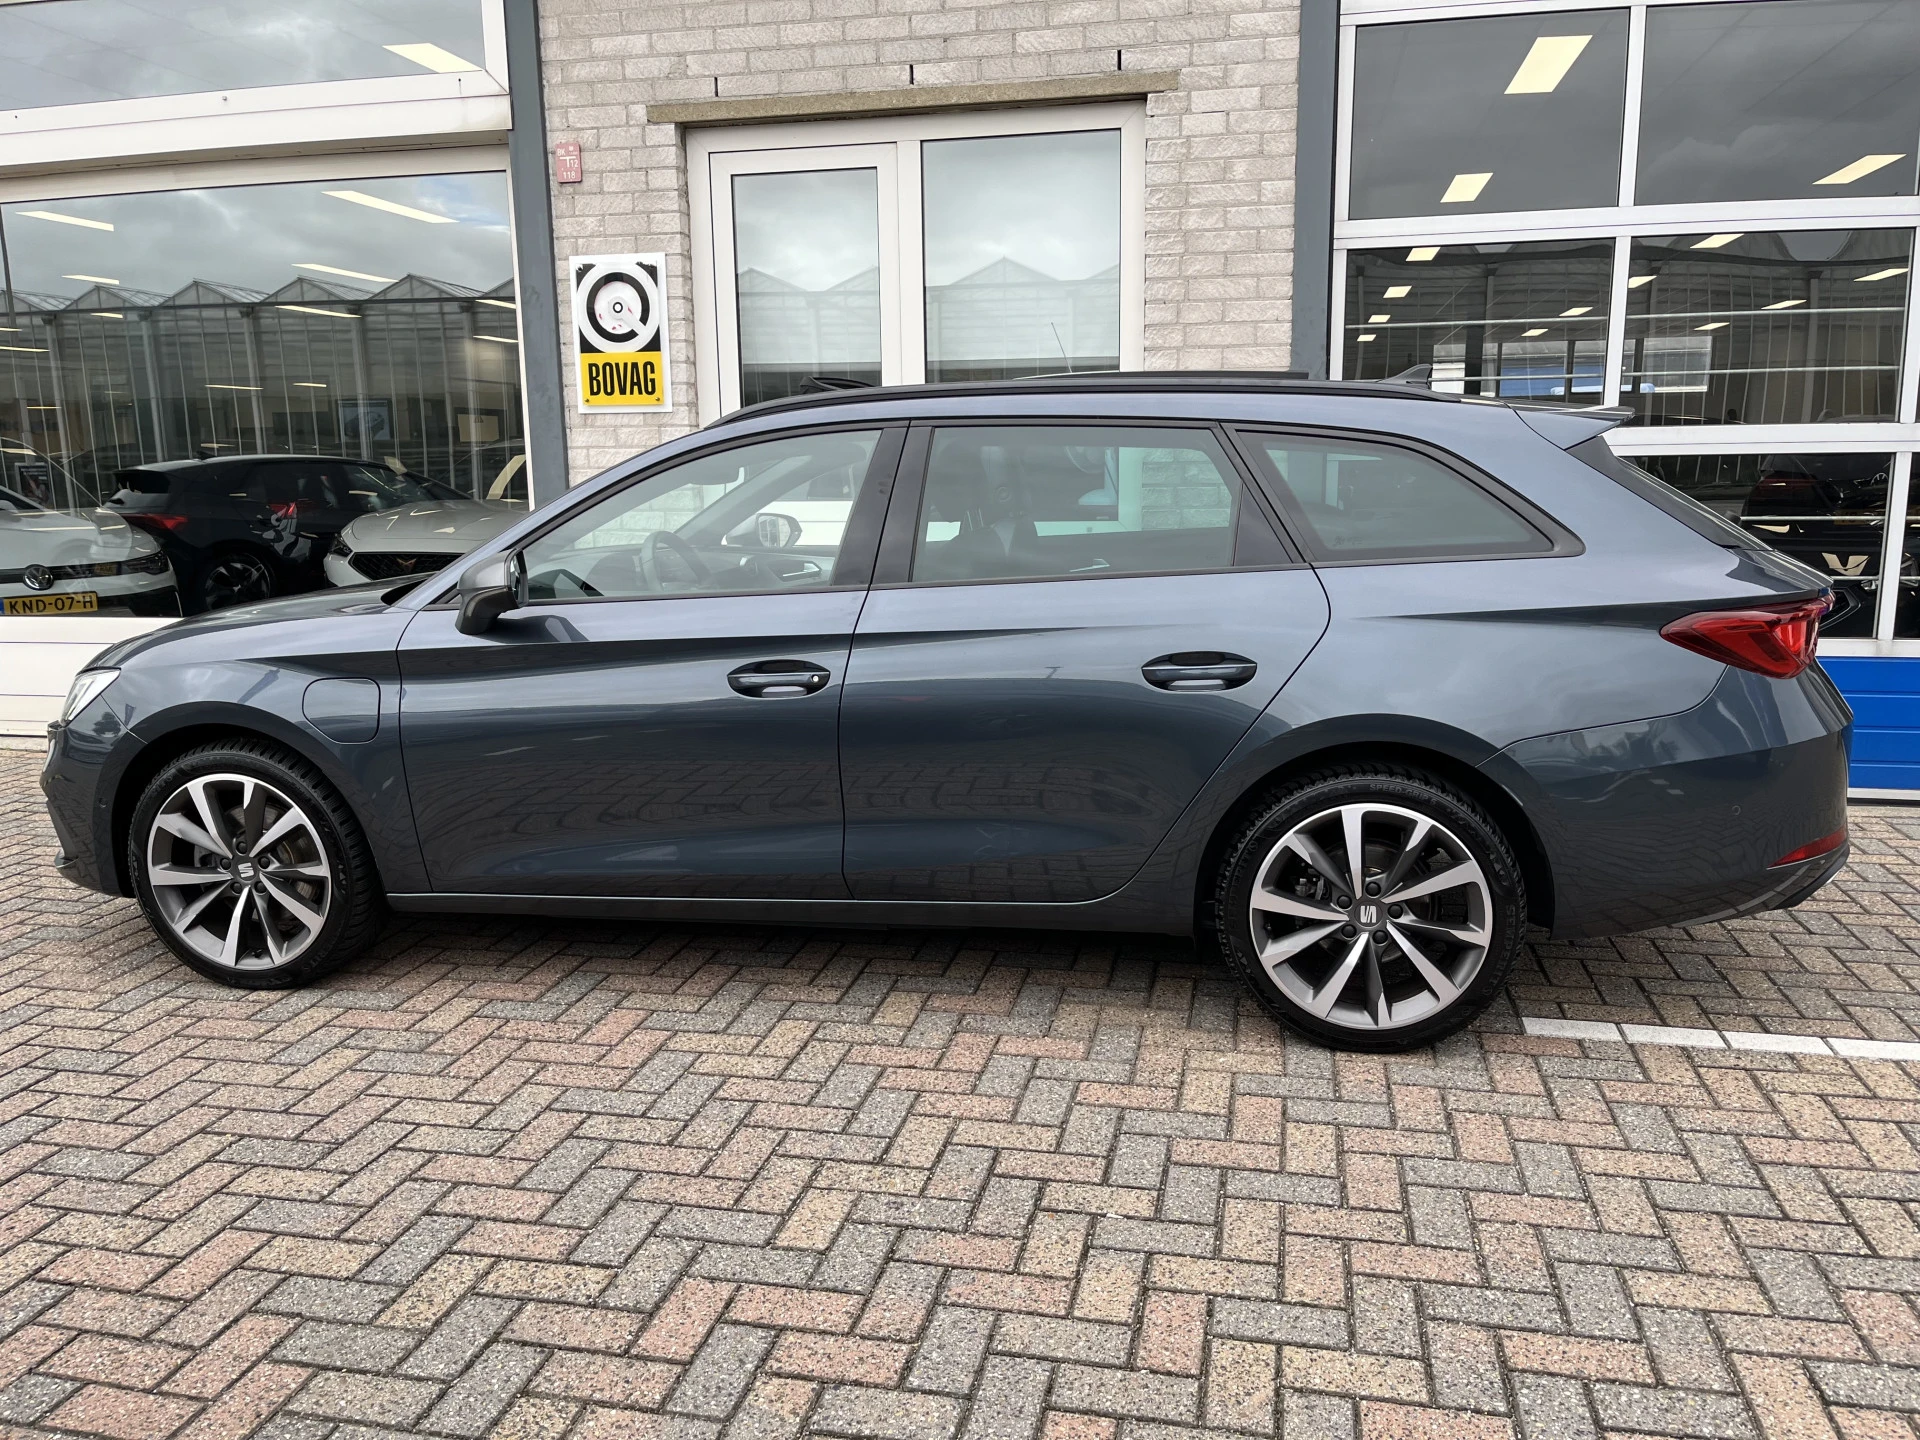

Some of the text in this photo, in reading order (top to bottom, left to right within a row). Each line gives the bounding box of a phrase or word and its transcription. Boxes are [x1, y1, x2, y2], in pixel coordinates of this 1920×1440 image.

[563, 171, 576, 180] 118
[588, 361, 656, 396] BOVAG
[9, 595, 93, 614] KND-07-H
